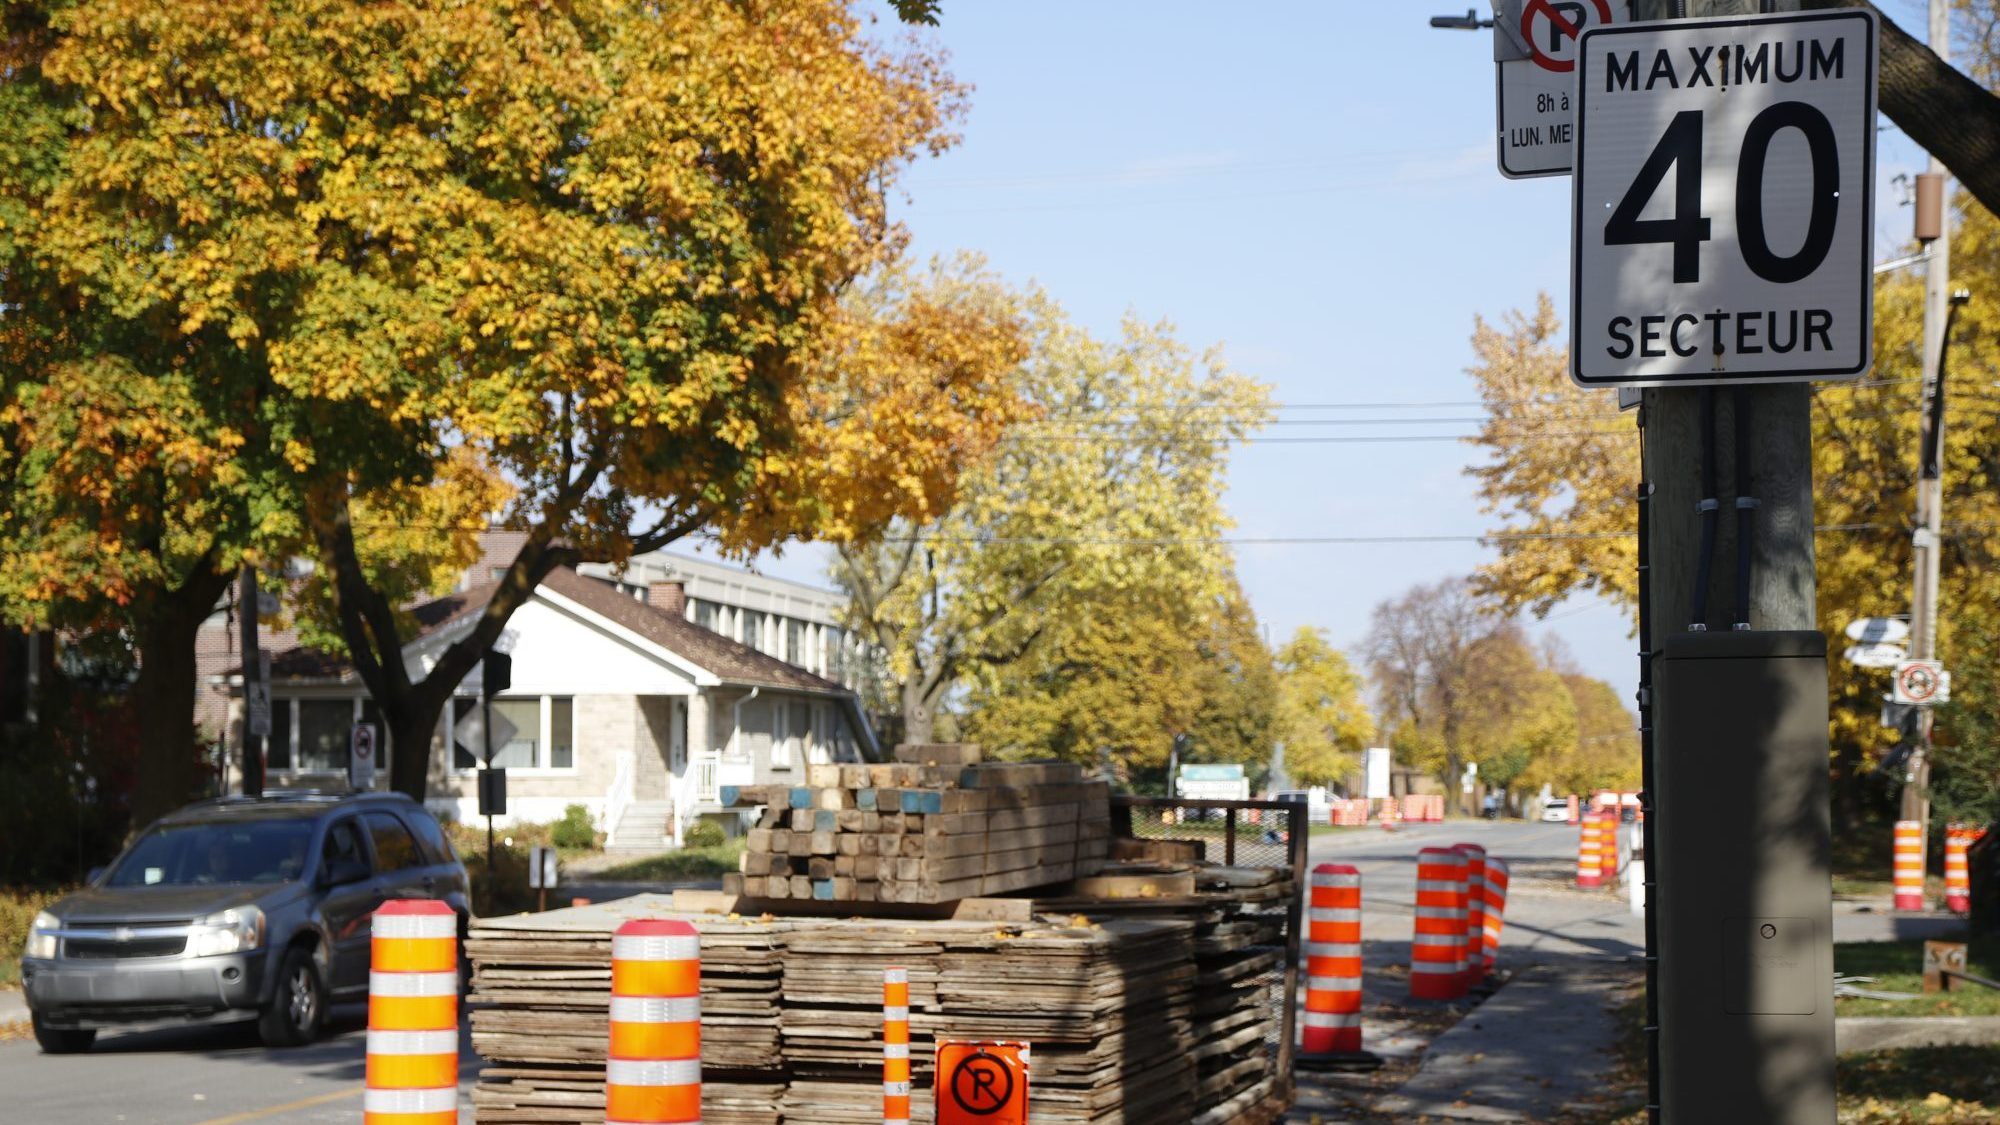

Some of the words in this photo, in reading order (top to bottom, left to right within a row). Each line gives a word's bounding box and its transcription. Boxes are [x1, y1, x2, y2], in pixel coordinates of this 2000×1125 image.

[1606, 38, 1844, 92] MAXIMUM
[1537, 94, 1554, 113] 8h
[1561, 92, 1569, 111] à
[1511, 127, 1543, 148] LUN.
[1549, 124, 1573, 144] ME
[1604, 101, 1840, 284] 40
[1606, 310, 1834, 359] SECTEUR
